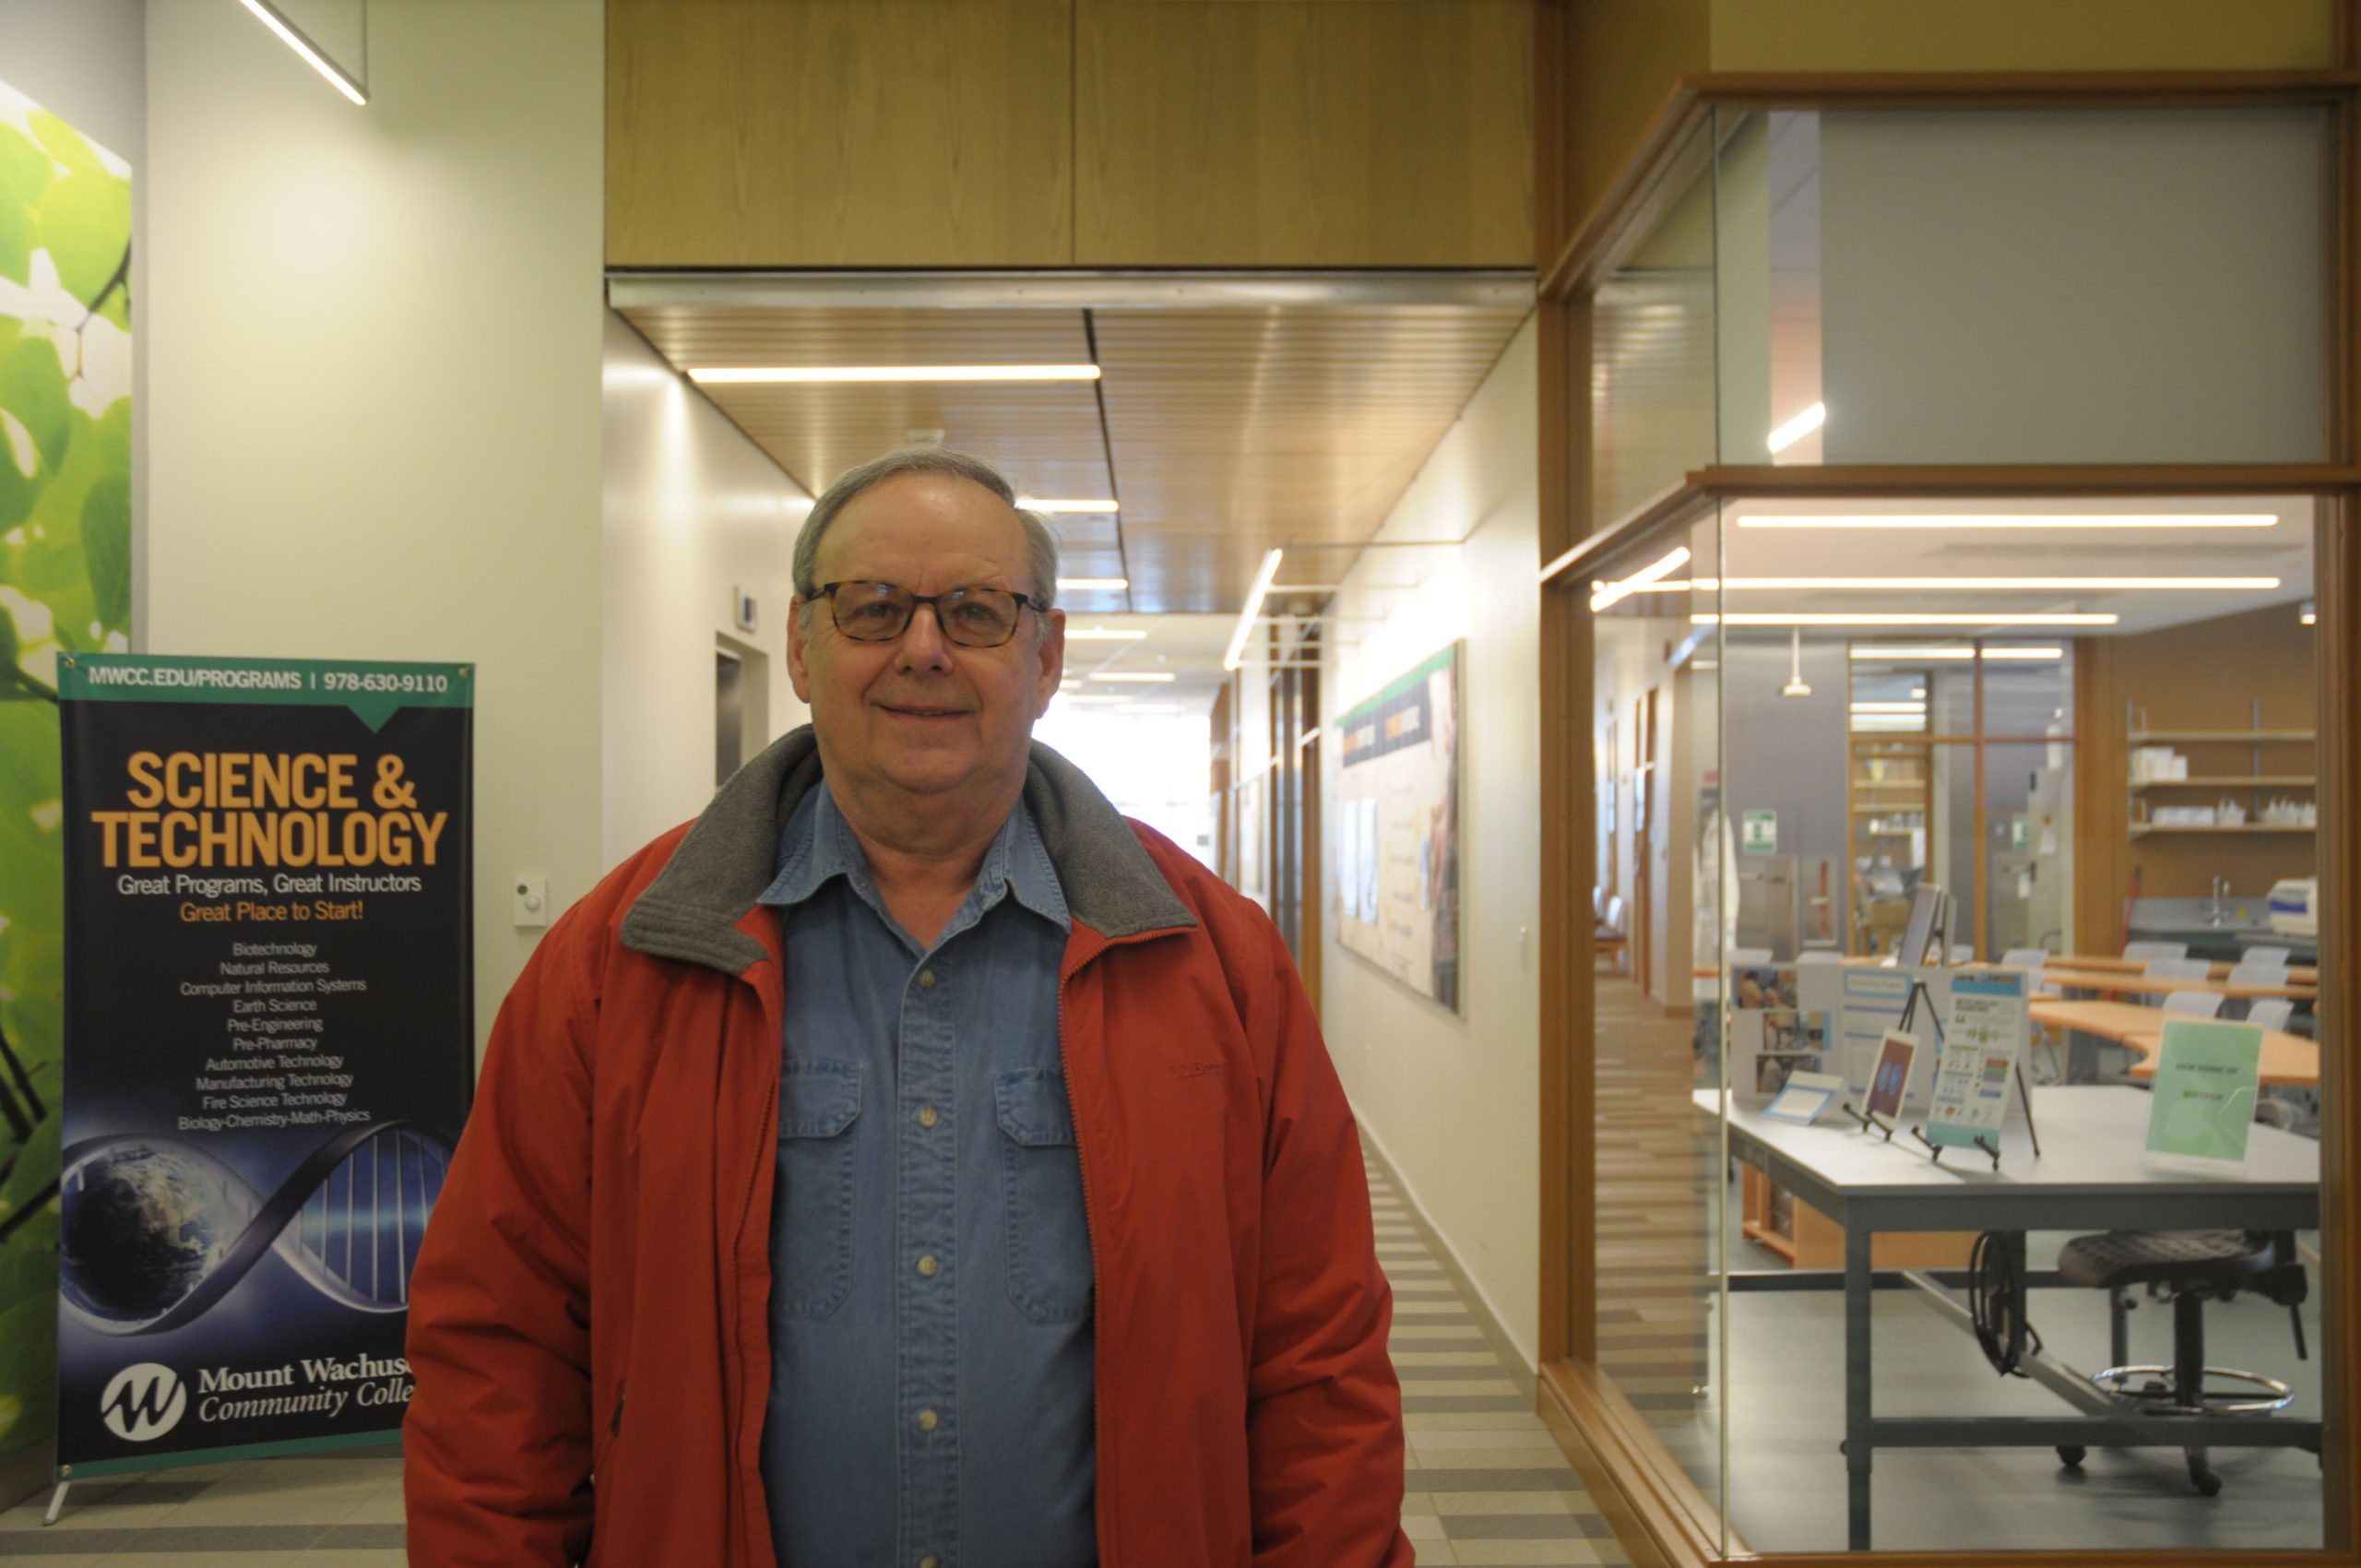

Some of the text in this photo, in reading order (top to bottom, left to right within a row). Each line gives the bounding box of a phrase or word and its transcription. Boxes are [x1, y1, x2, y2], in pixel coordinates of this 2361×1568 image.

[89, 667, 302, 690] MWCC.EDU/PROGRAMS
[324, 672, 448, 693] 978-630-9110
[126, 751, 418, 810] SCIENCE &
[90, 811, 448, 868] TECHNOLOGY
[117, 873, 421, 897] Great Programs, Great Instructors
[179, 901, 363, 922] Great Place to Start!
[232, 942, 317, 958] Biotechnology
[219, 960, 329, 975] Natural Resources
[180, 979, 366, 999] Computer Information Systems
[232, 998, 317, 1013] Earth Science
[227, 1017, 324, 1034] Pre-Engineering
[232, 1037, 317, 1052] Pre-Pharmacy
[205, 1054, 343, 1071] Automotive Technology
[196, 1073, 353, 1092] Manufacturing Technology
[202, 1092, 347, 1110] Fire Science Technology
[178, 1109, 371, 1132] Biology-Chemistry-Math-Physics
[198, 1367, 293, 1394] Mount
[199, 1386, 349, 1422] Community
